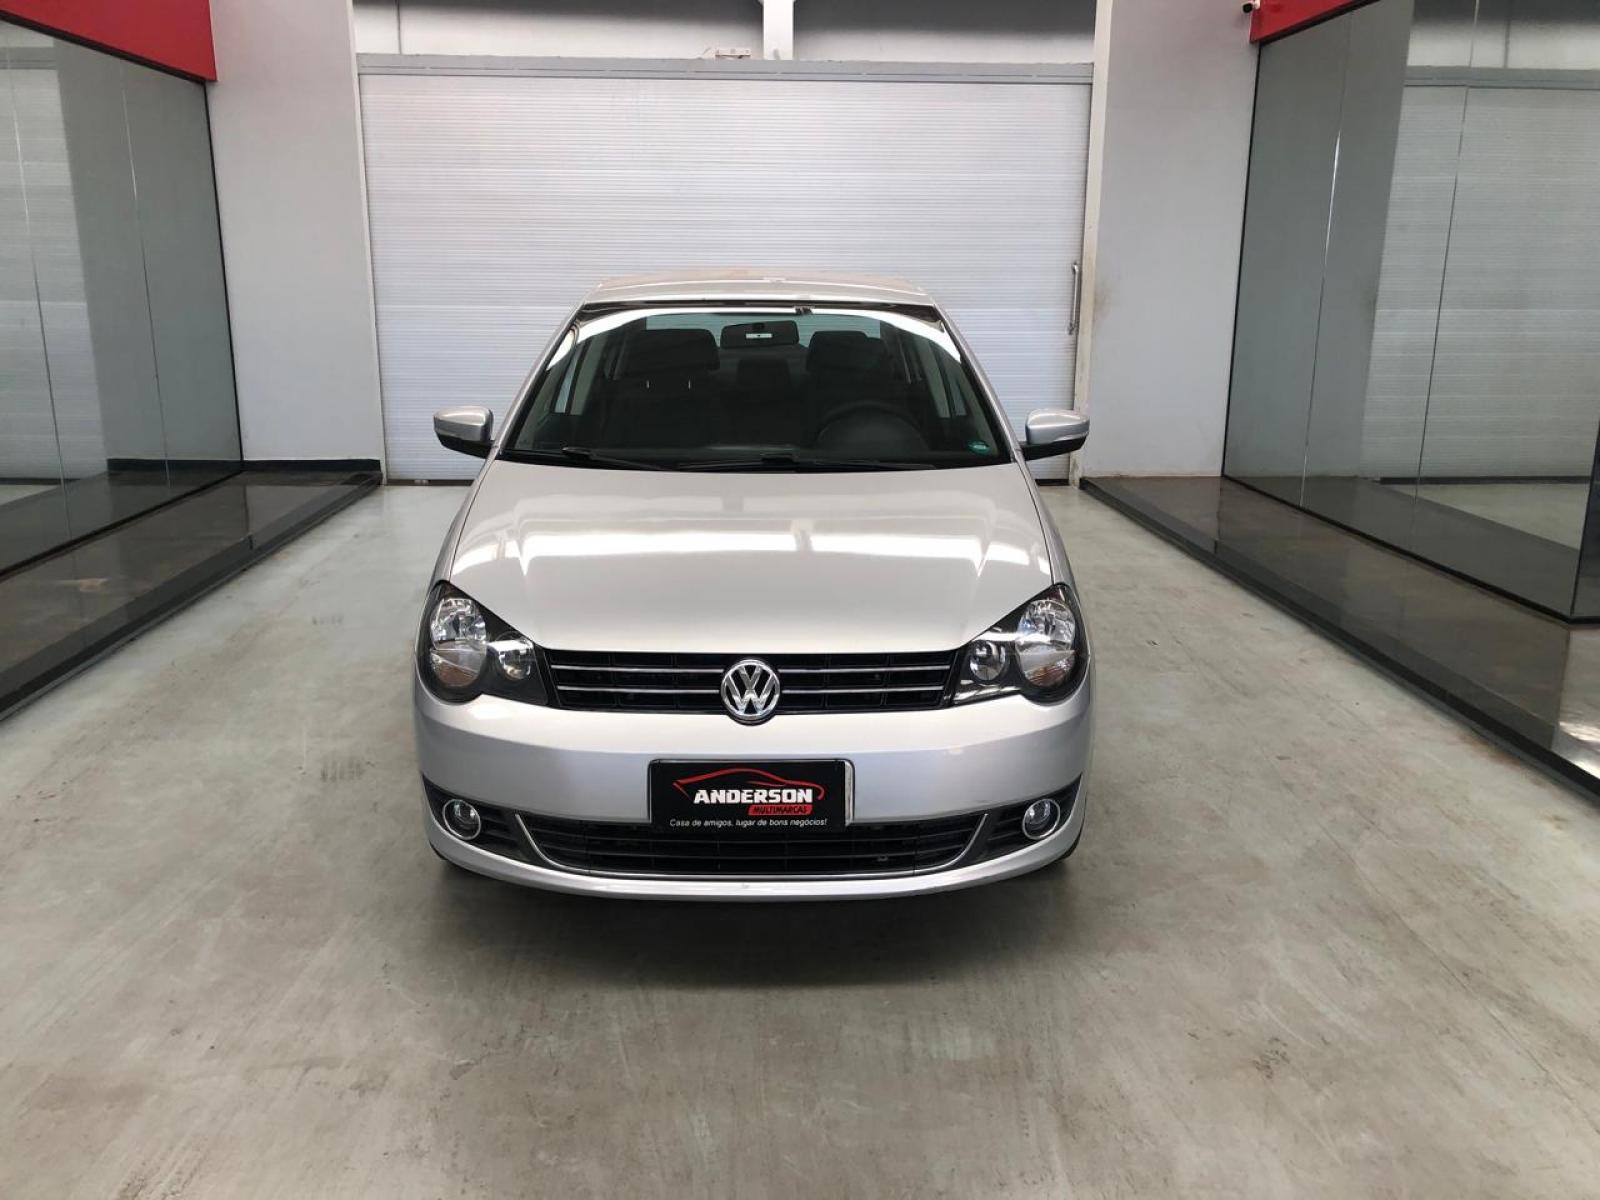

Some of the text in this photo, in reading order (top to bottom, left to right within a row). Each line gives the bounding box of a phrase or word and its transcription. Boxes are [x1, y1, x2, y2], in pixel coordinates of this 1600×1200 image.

[693, 789, 813, 804] ANDERSON
[753, 806, 808, 814] MULTIMARCAS
[669, 819, 690, 827] Casa
[691, 819, 702, 827] de
[735, 819, 755, 828] lugar
[757, 818, 767, 826] de
[769, 818, 789, 827] bons
